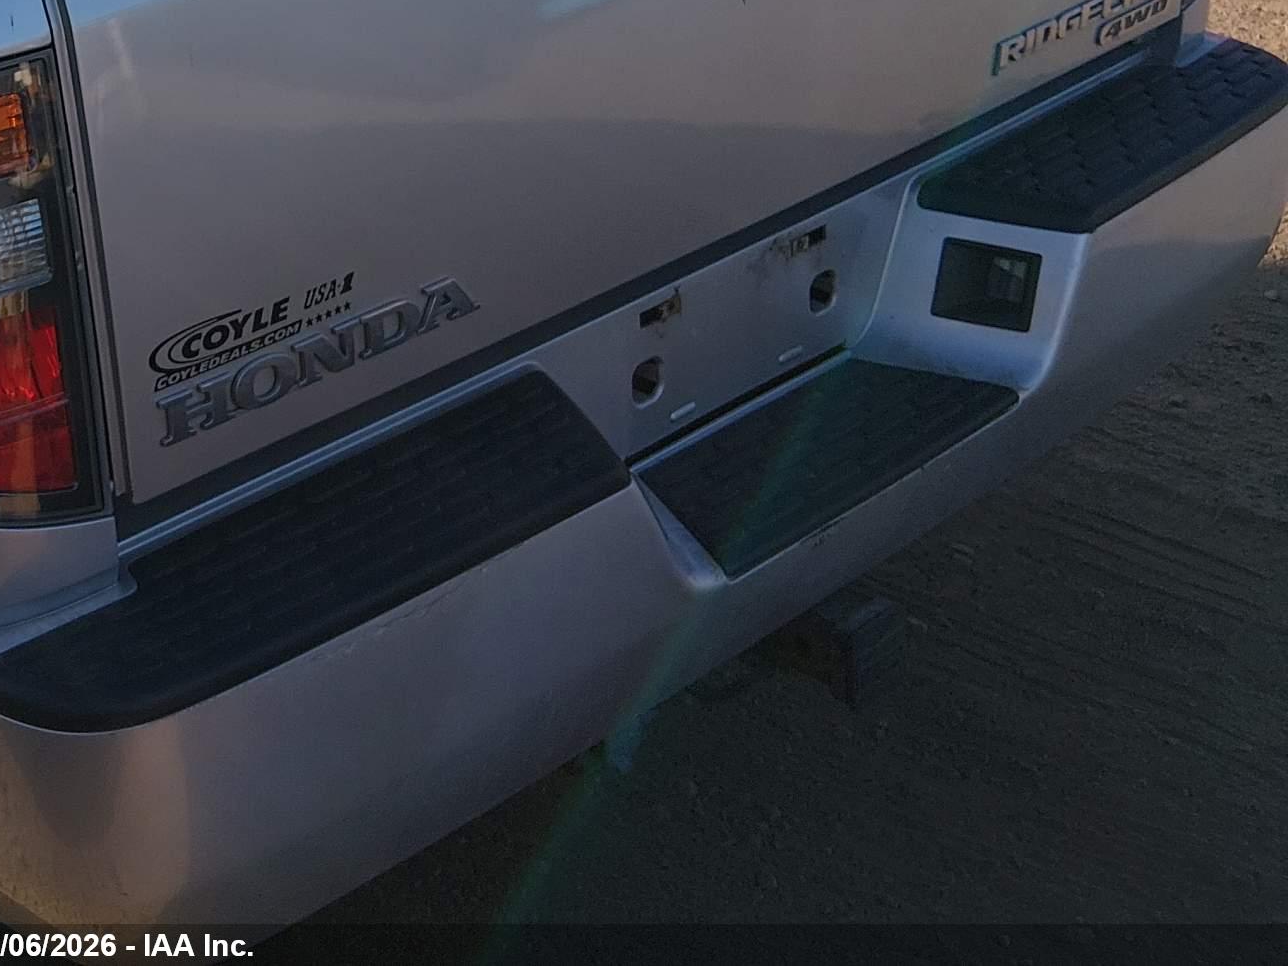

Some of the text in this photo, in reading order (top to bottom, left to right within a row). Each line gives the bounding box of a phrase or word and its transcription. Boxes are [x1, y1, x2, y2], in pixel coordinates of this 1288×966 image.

[155, 320, 302, 391] COYLEDEALS.COM
[155, 275, 480, 447] HONDA
[182, 296, 290, 359] COYLE
